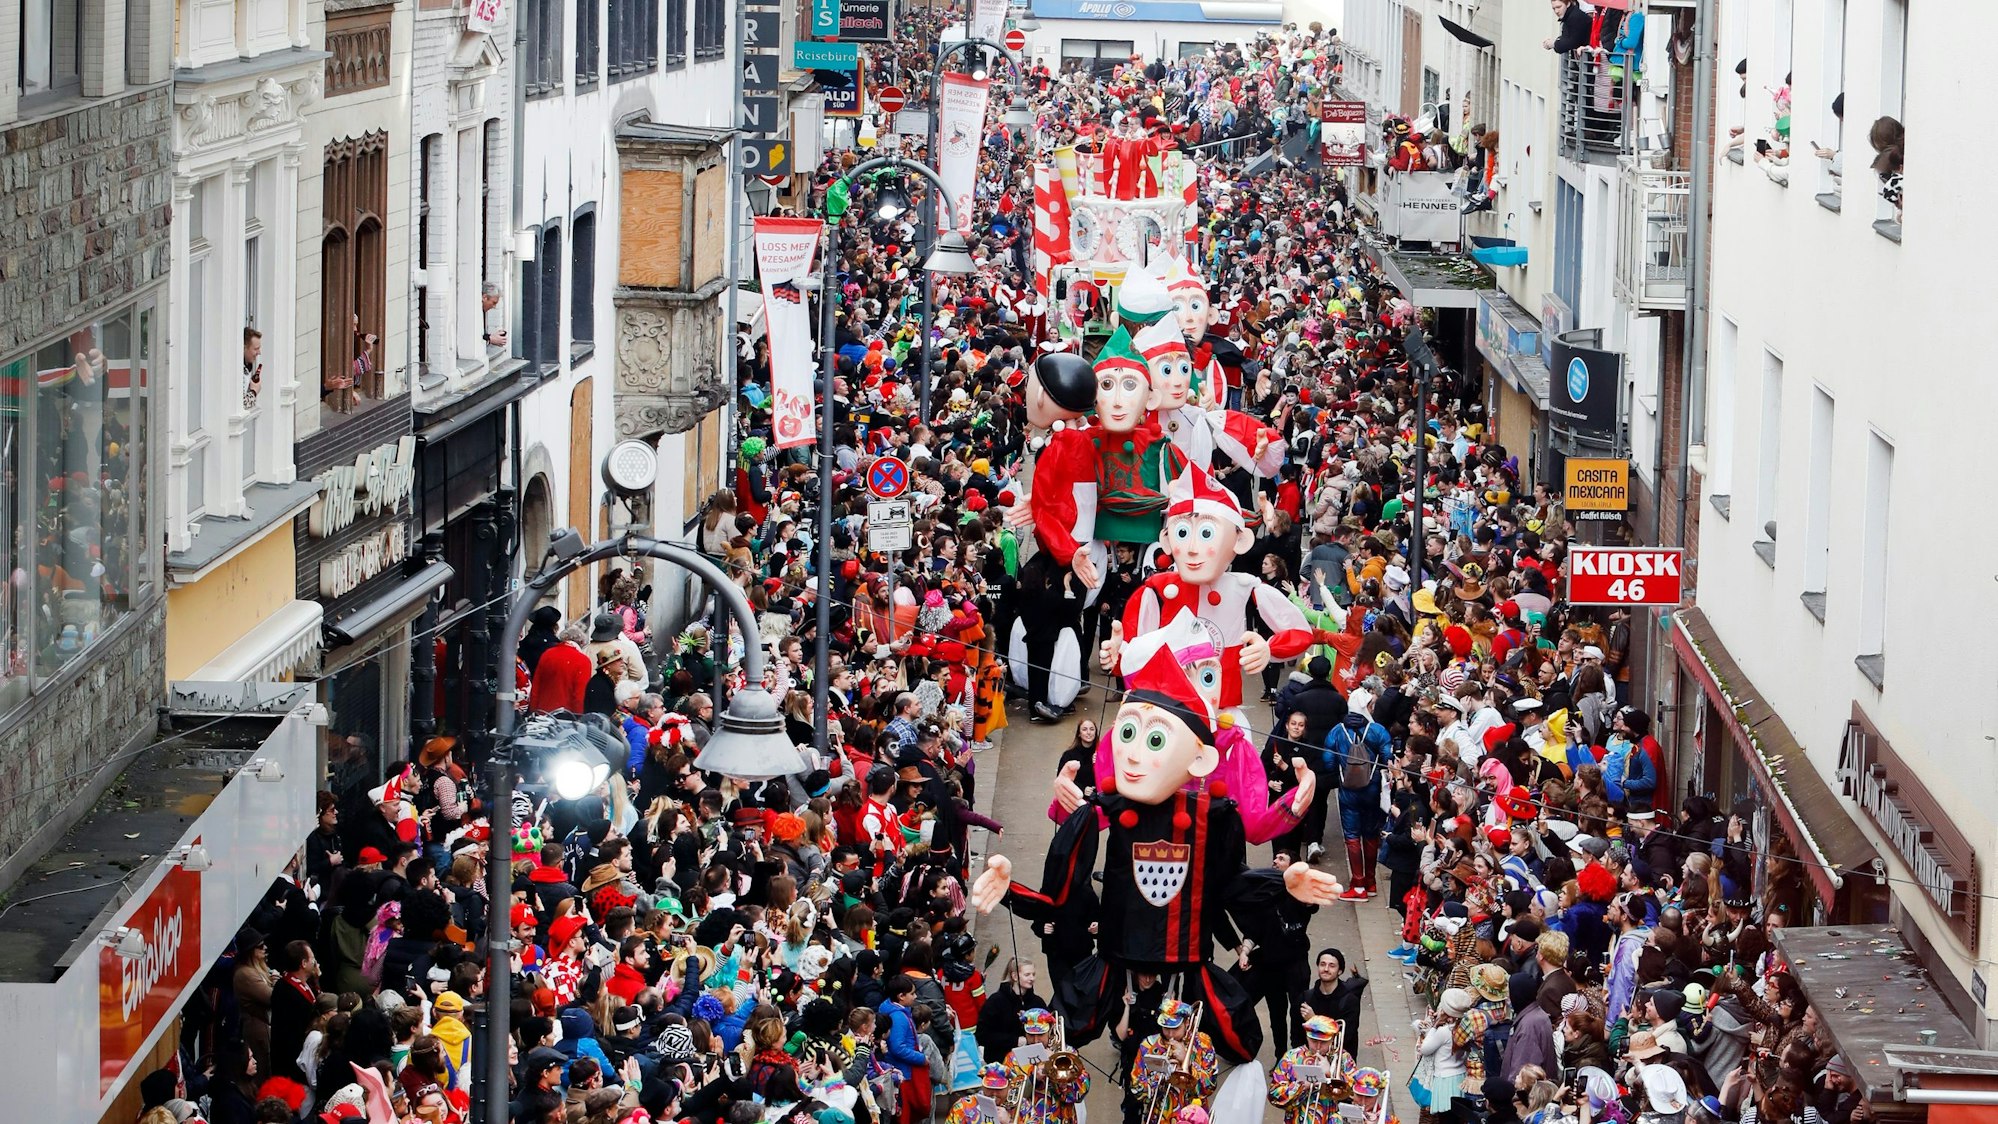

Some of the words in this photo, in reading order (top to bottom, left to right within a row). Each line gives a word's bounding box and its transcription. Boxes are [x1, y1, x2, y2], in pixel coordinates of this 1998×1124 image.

[1079, 2, 1112, 13] APOLLO
[796, 51, 856, 62] Reisebüro
[824, 91, 855, 101] ALDI
[1403, 202, 1457, 210] HENNES
[762, 242, 788, 251] LOSS
[790, 242, 811, 251] MER
[1577, 469, 1618, 483] CASITA
[1569, 485, 1625, 499] MEXICANA
[1580, 511, 1599, 520] Gaffel
[1600, 511, 1622, 520] Kölsch
[1572, 552, 1679, 577] KIOSK
[1607, 579, 1646, 602] 46
[523, 906, 534, 918] M
